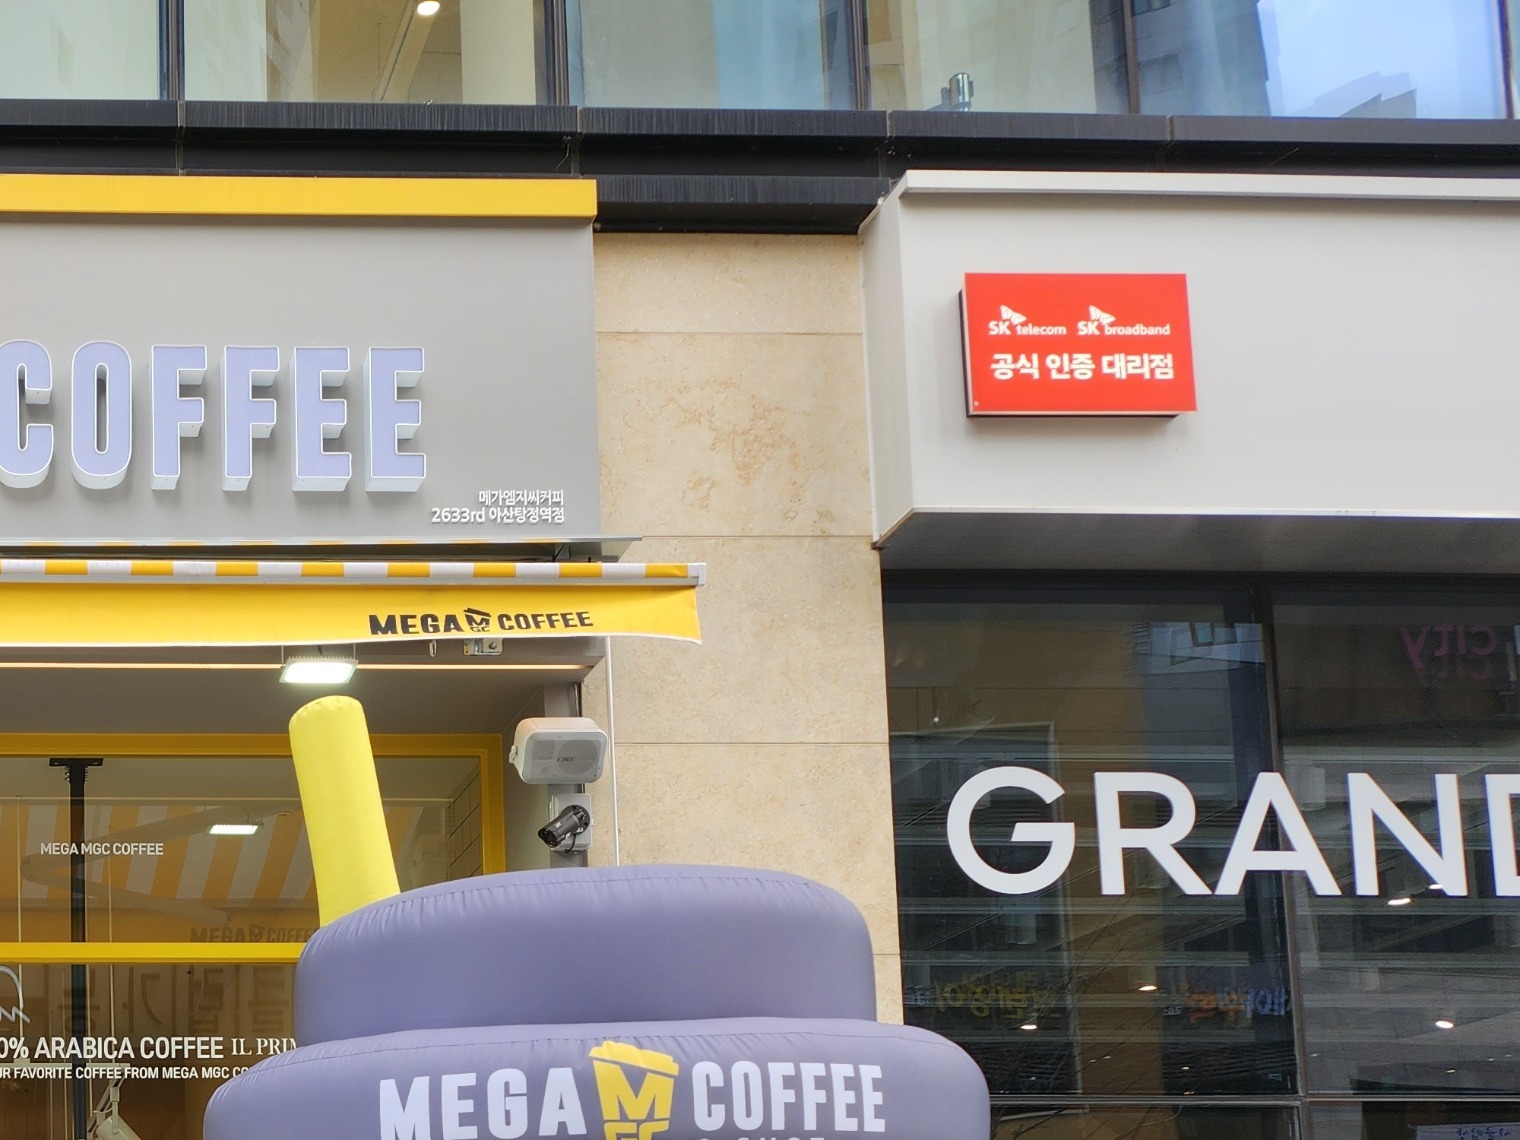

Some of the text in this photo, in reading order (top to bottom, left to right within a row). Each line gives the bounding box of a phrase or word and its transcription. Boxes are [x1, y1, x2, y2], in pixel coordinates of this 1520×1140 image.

[988, 319, 1067, 336] SK telecom
[1077, 319, 1171, 336] SK broadband
[990, 352, 1175, 380] 공식 인증 대리점
[477, 487, 565, 507] 메가엠지씨커피
[431, 505, 565, 524] 2633rd 아산탕정역점
[369, 612, 464, 636] MEGA
[496, 611, 594, 632] COFFEE
[40, 843, 164, 855] MEGA MGC COFFEE
[34, 1036, 132, 1059] ARABICA
[140, 1036, 224, 1059] COFFEE
[231, 1037, 253, 1056] IL
[14, 1066, 72, 1079] FAVORITE
[75, 1066, 122, 1079] COFFEE
[123, 1066, 159, 1079] FROM
[162, 1066, 198, 1079] MEGA
[202, 1066, 229, 1079] MGC
[692, 1060, 886, 1135] COFFEE
